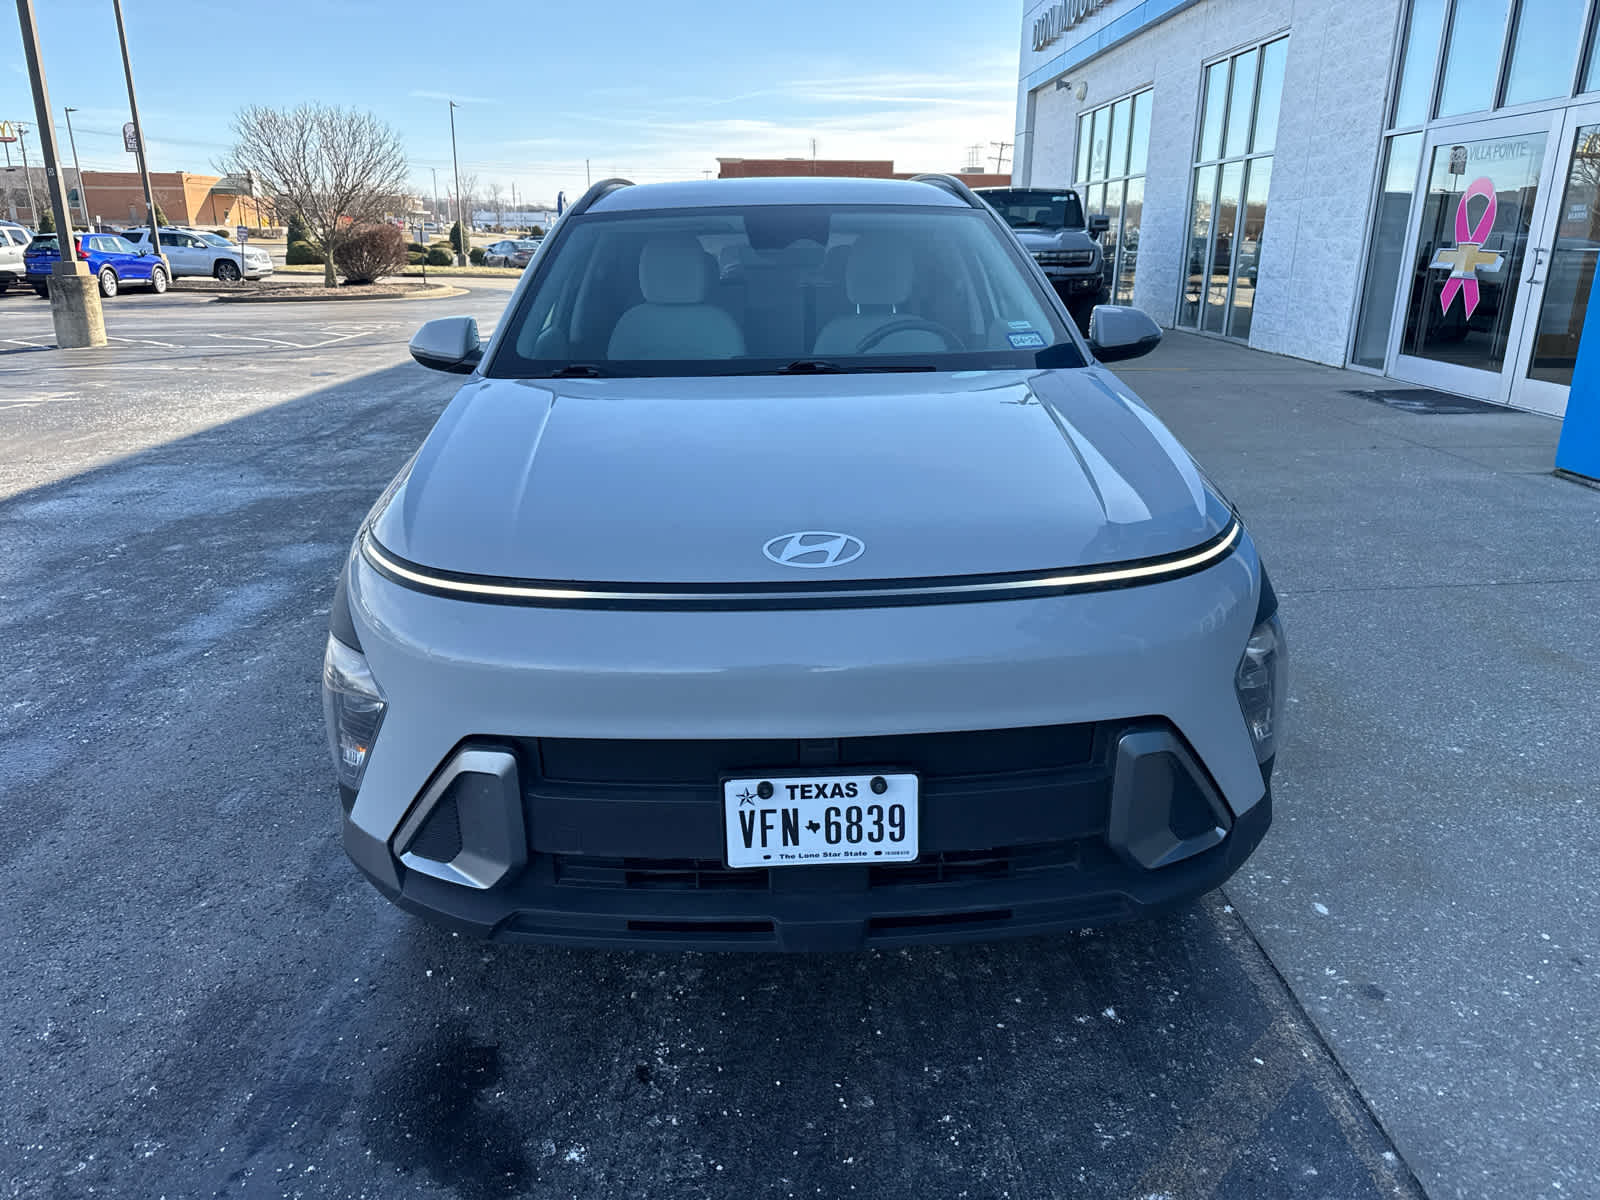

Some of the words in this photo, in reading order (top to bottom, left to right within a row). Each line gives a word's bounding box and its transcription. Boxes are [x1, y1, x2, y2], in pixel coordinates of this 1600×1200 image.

[1469, 143, 1492, 160] VILLA
[1494, 141, 1528, 158] POINTE
[785, 782, 858, 800] TEXAS
[739, 808, 800, 849] VFN
[824, 804, 906, 845] 6839
